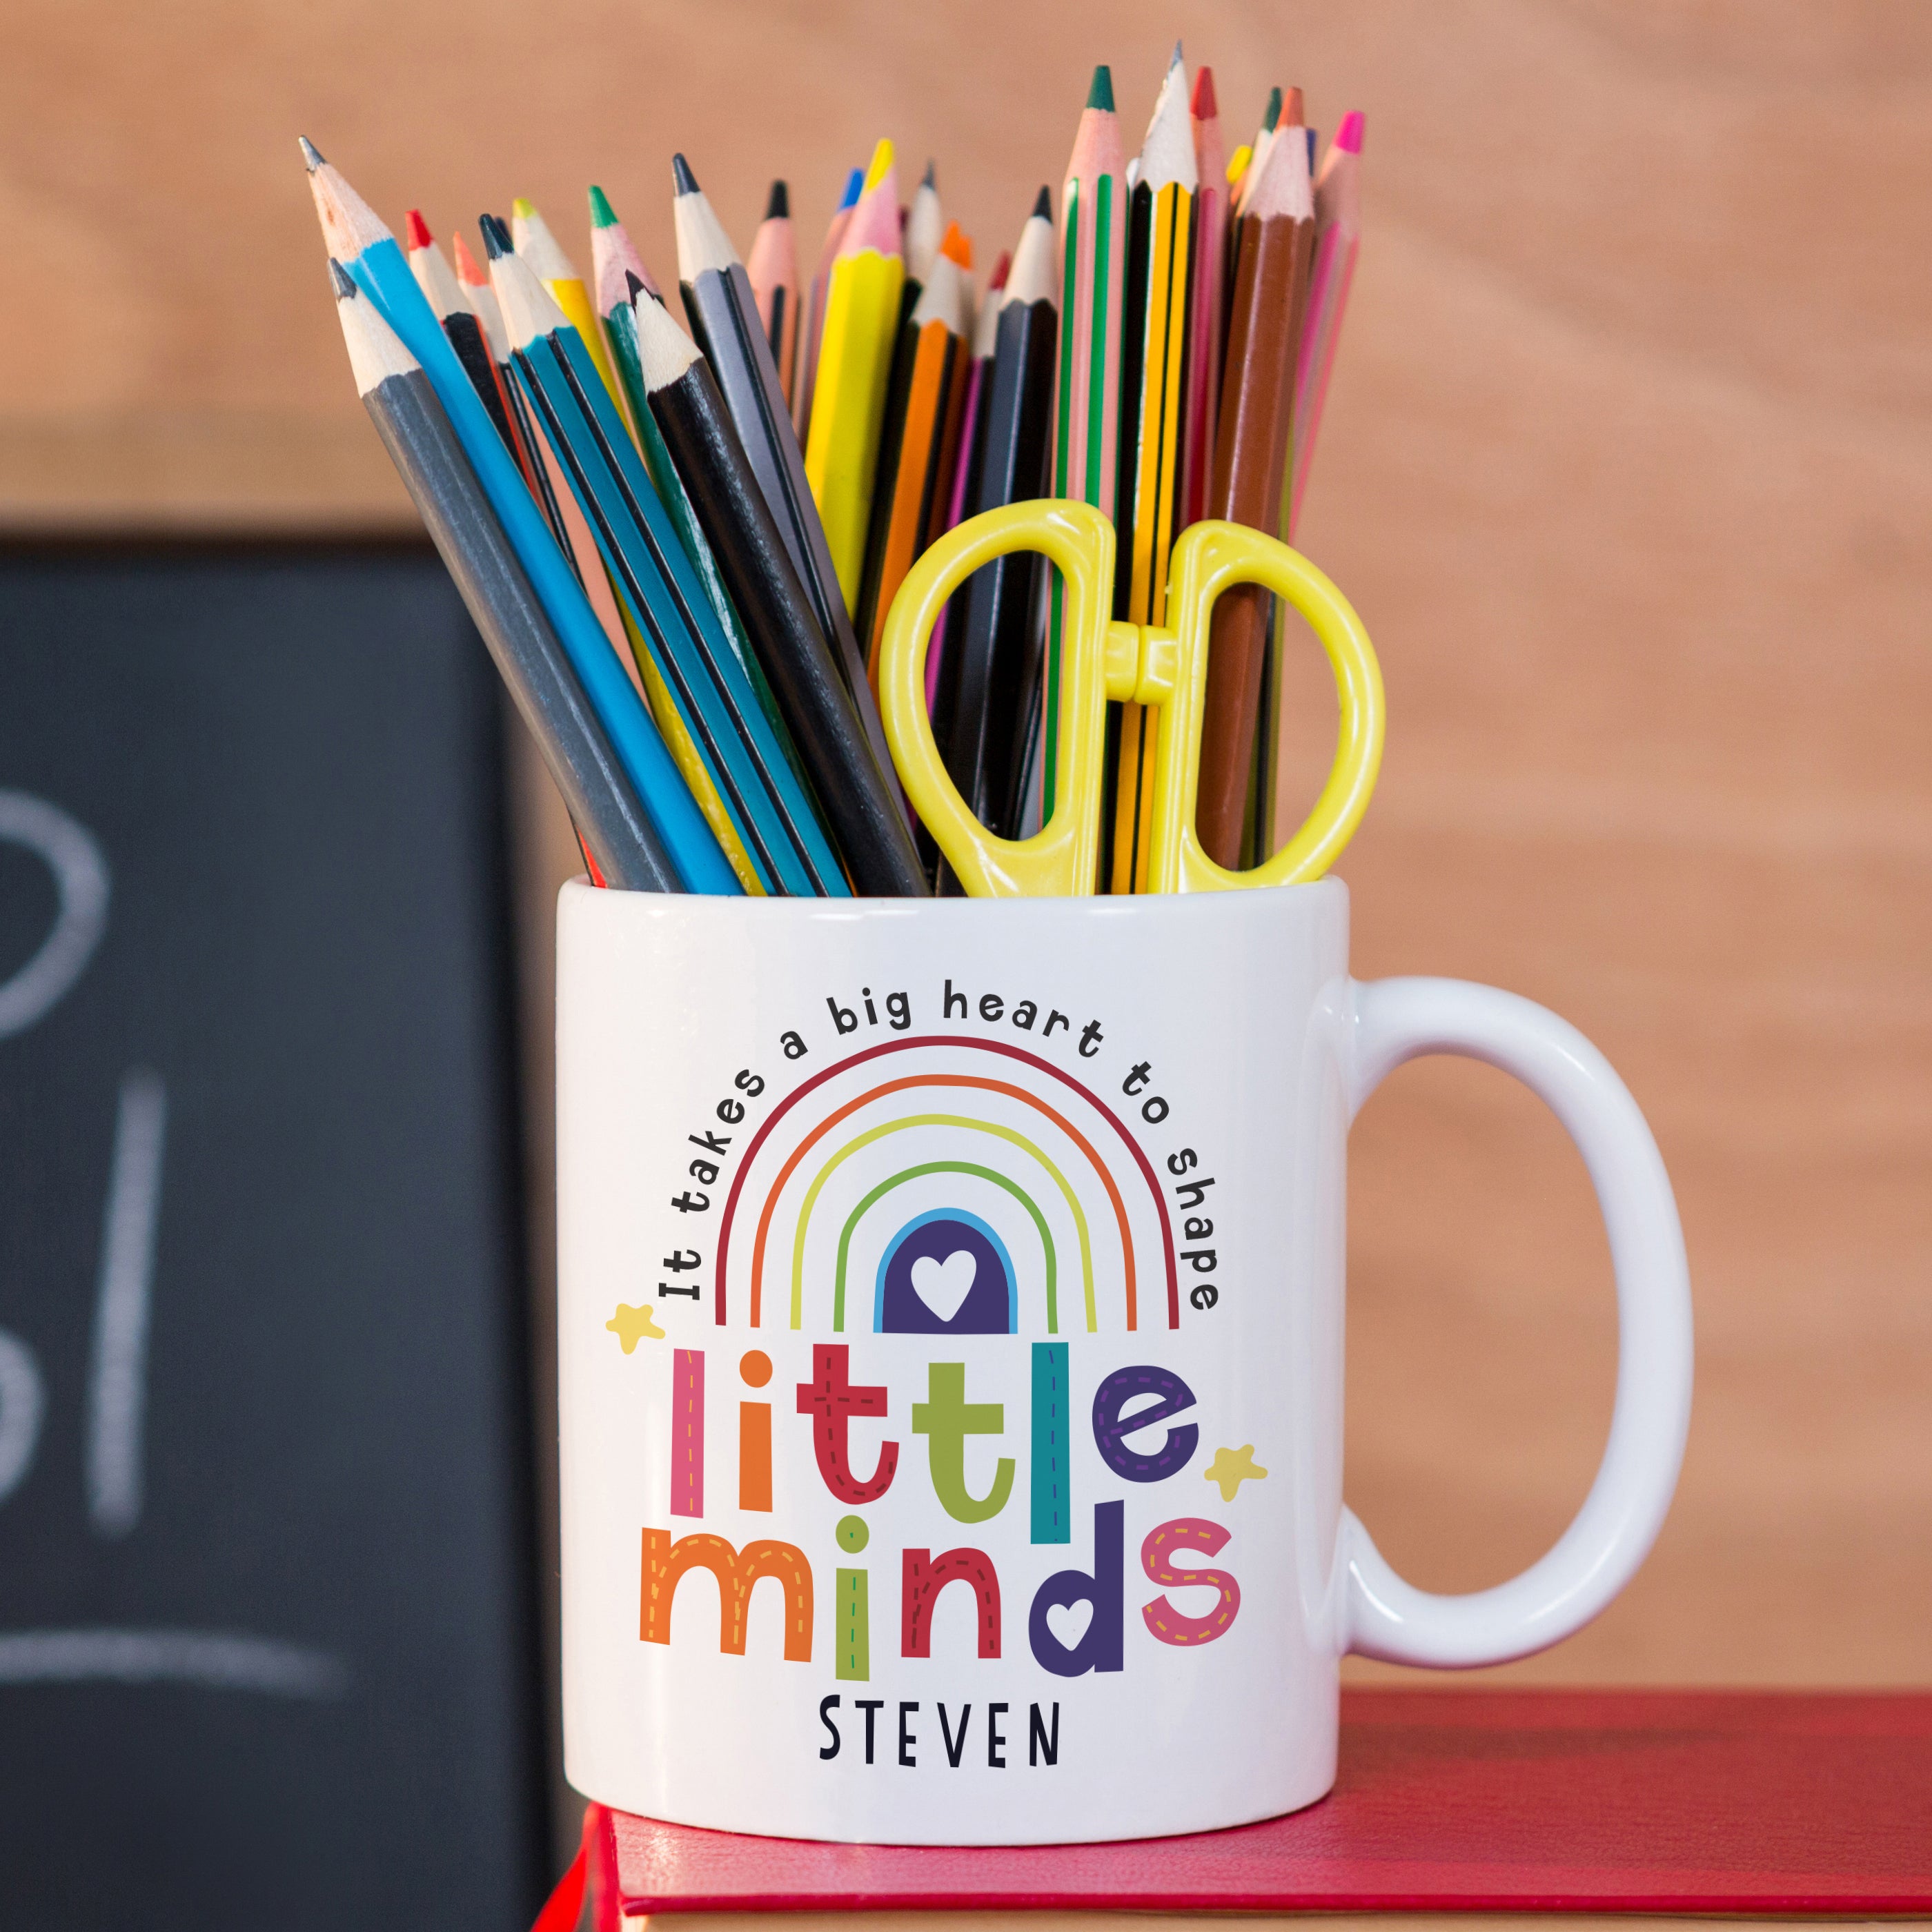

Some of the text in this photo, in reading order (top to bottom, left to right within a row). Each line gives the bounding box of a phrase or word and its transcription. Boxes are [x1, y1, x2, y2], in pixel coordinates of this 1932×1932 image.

[658, 980, 1219, 1310] It takes a big heart to shape
[671, 1342, 1199, 1545] little
[639, 1500, 1241, 1682] minds
[819, 1694, 1060, 1768] STEVEN
